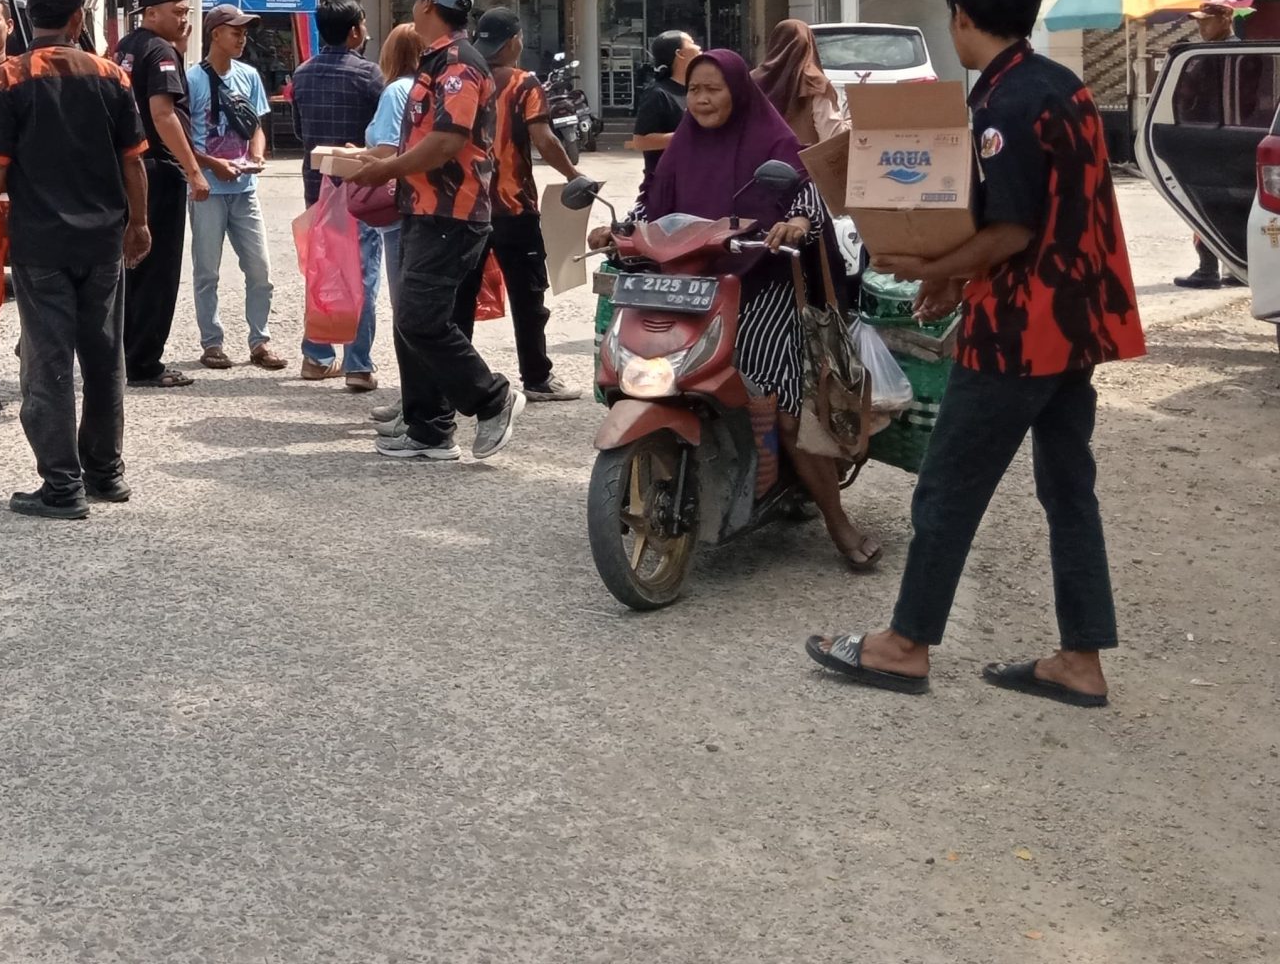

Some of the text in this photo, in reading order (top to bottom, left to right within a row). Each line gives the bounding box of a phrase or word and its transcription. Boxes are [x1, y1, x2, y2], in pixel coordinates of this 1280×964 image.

[877, 150, 932, 169] AQUA
[623, 277, 710, 294] K 2125 DY
